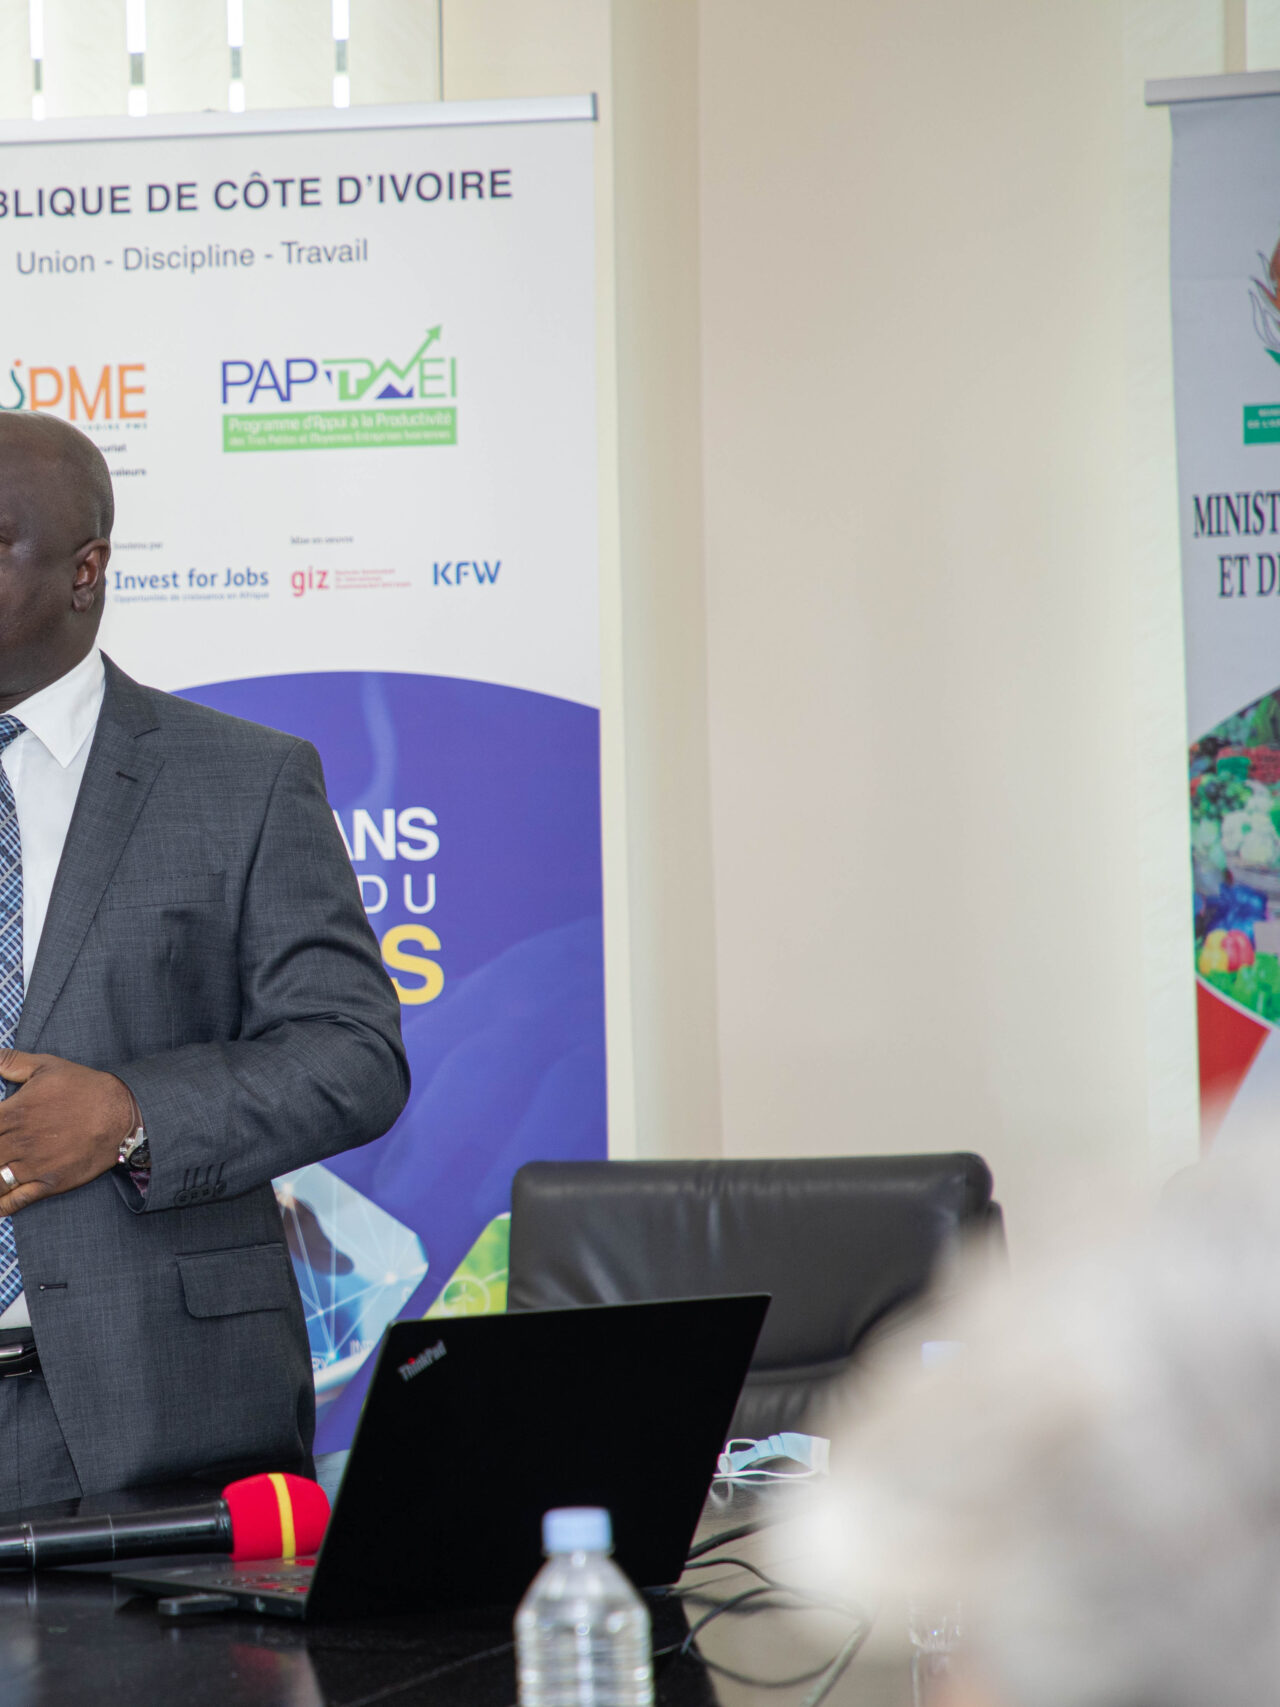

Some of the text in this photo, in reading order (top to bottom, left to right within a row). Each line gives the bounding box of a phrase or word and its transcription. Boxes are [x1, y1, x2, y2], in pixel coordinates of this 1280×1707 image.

[147, 182, 199, 213] DE
[214, 171, 322, 211] CÔTE
[337, 169, 513, 205] D'IVOIRE
[17, 250, 96, 275] Union
[123, 245, 255, 274] Discipline
[281, 238, 368, 265] Travail
[229, 416, 299, 434] Programme
[114, 566, 269, 590] Invest for Jobs
[291, 565, 330, 597] giz
[1217, 552, 1280, 599] ET D
[398, 1339, 448, 1382] ThinkPad
